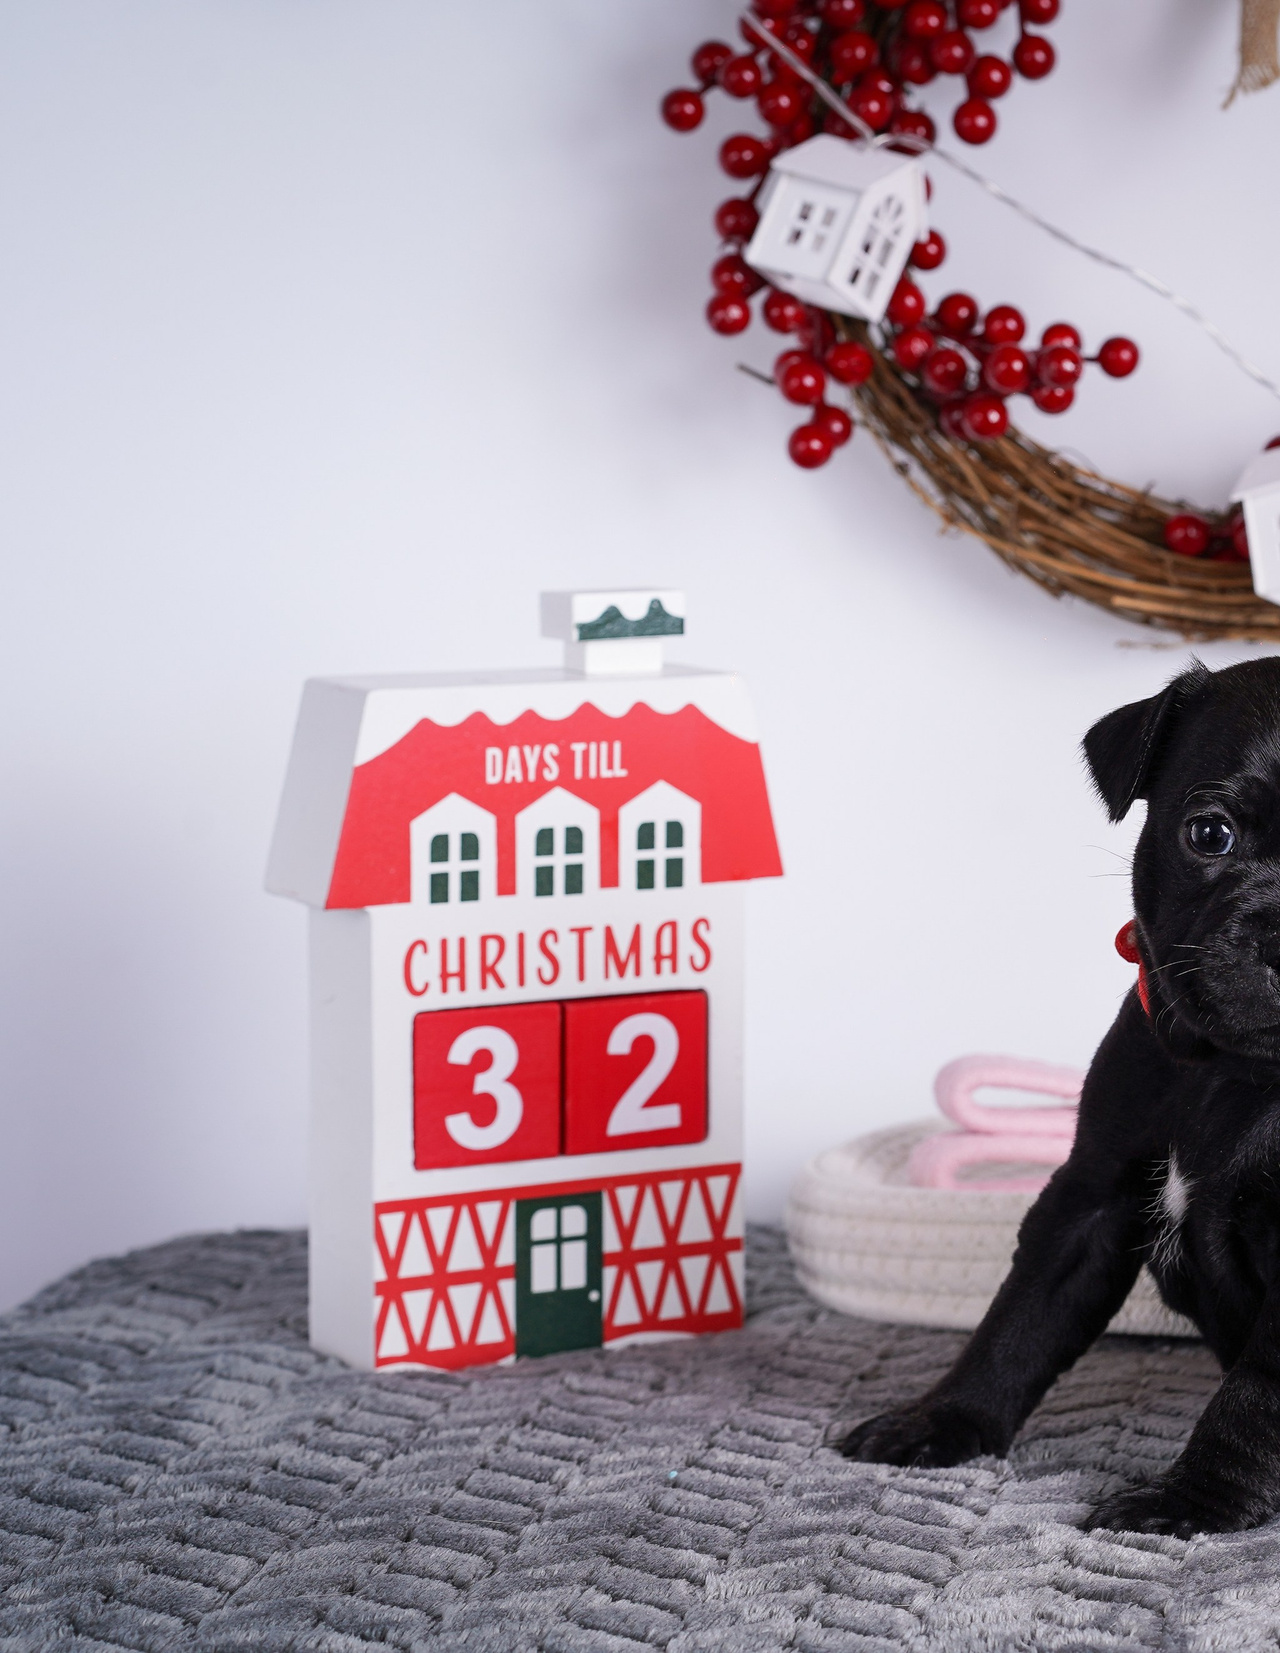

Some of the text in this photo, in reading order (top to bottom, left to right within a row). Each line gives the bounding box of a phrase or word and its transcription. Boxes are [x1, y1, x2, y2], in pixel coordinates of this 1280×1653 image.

[485, 741, 628, 785] DAYS TILL
[403, 917, 713, 997] CHRISTMAS
